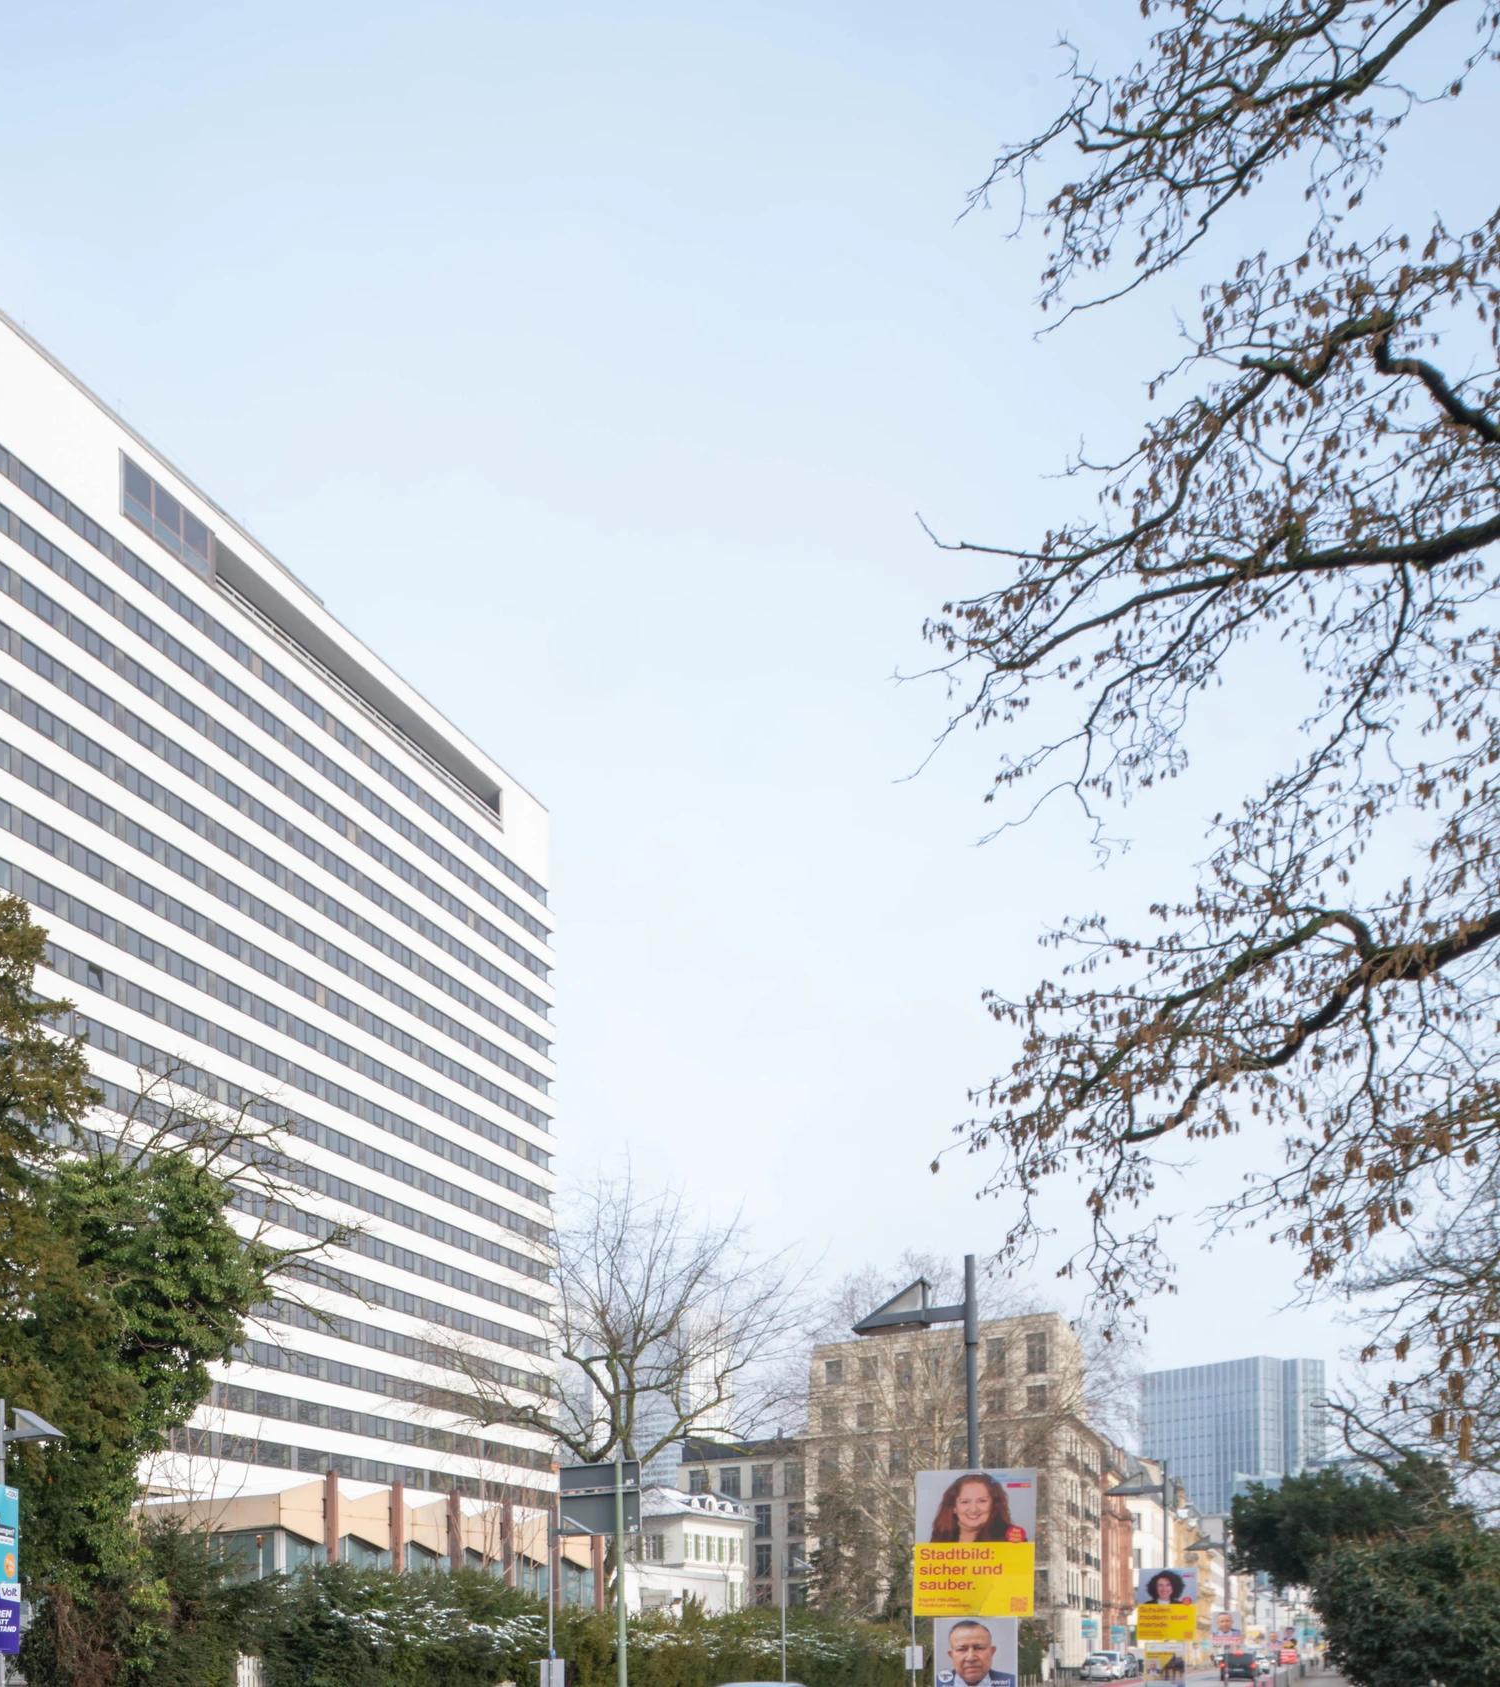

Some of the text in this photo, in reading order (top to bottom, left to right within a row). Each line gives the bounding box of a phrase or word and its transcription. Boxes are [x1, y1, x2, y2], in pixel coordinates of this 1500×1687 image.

[920, 1548, 995, 1560] Stadtbild:
[920, 1563, 1003, 1576] sicher und
[919, 1579, 976, 1590] sauber.
[1, 1587, 18, 1597] Volt
